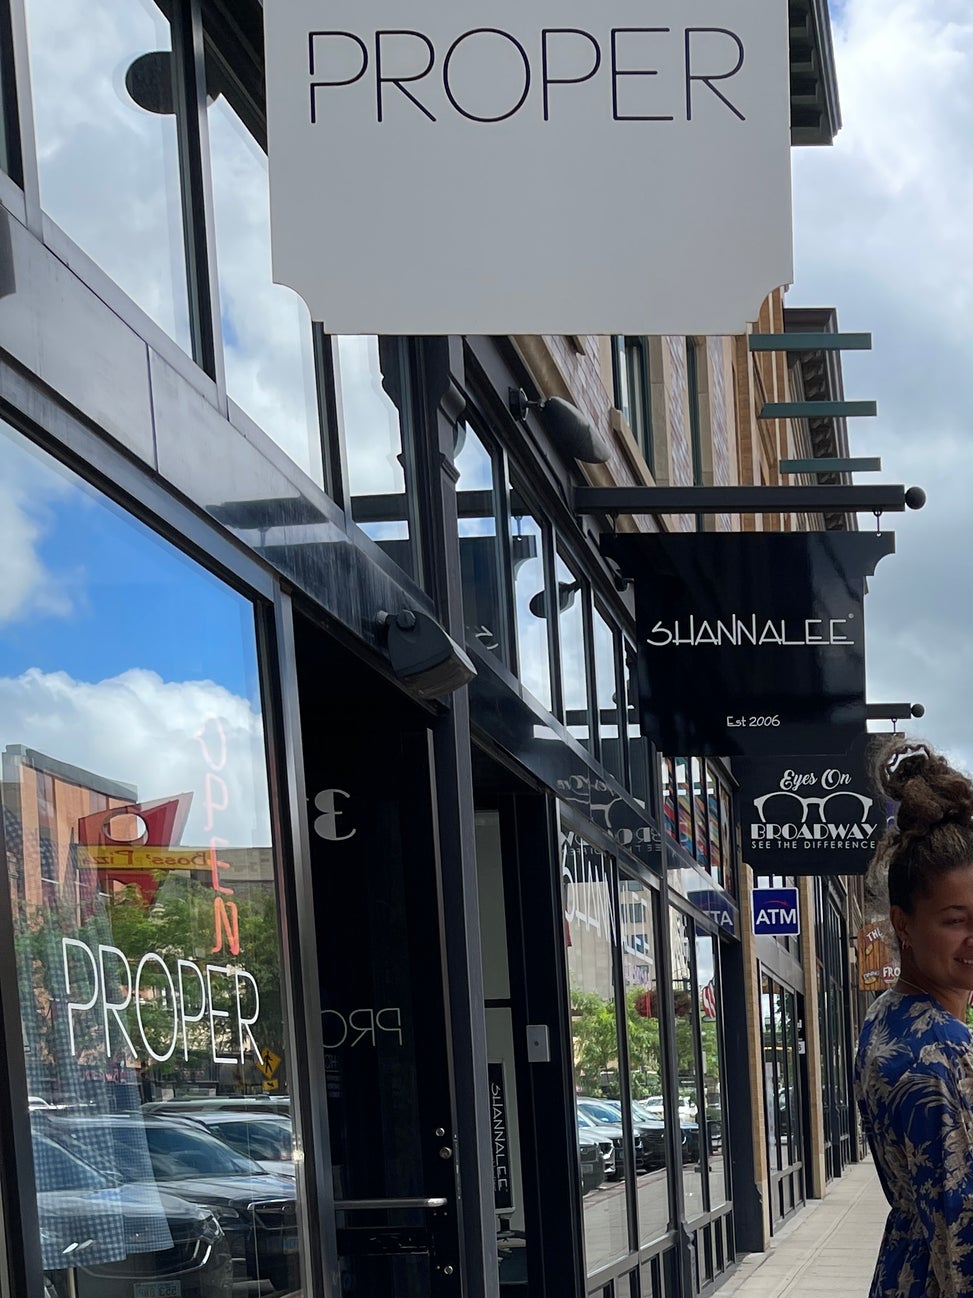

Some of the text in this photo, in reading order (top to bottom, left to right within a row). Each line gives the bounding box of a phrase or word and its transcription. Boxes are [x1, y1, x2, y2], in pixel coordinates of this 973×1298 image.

[308, 27, 746, 123] PROPER
[647, 613, 855, 646] SHANNALEE
[726, 714, 781, 727] Est 2006
[779, 768, 852, 791] Eyes On
[194, 712, 241, 956] OPEN
[751, 823, 878, 840] BROADWAY
[751, 840, 876, 849] SEE THE DIFFERENCE
[755, 908, 797, 925] ATM
[883, 966, 901, 978] FRO
[62, 937, 264, 1066] PROPER
